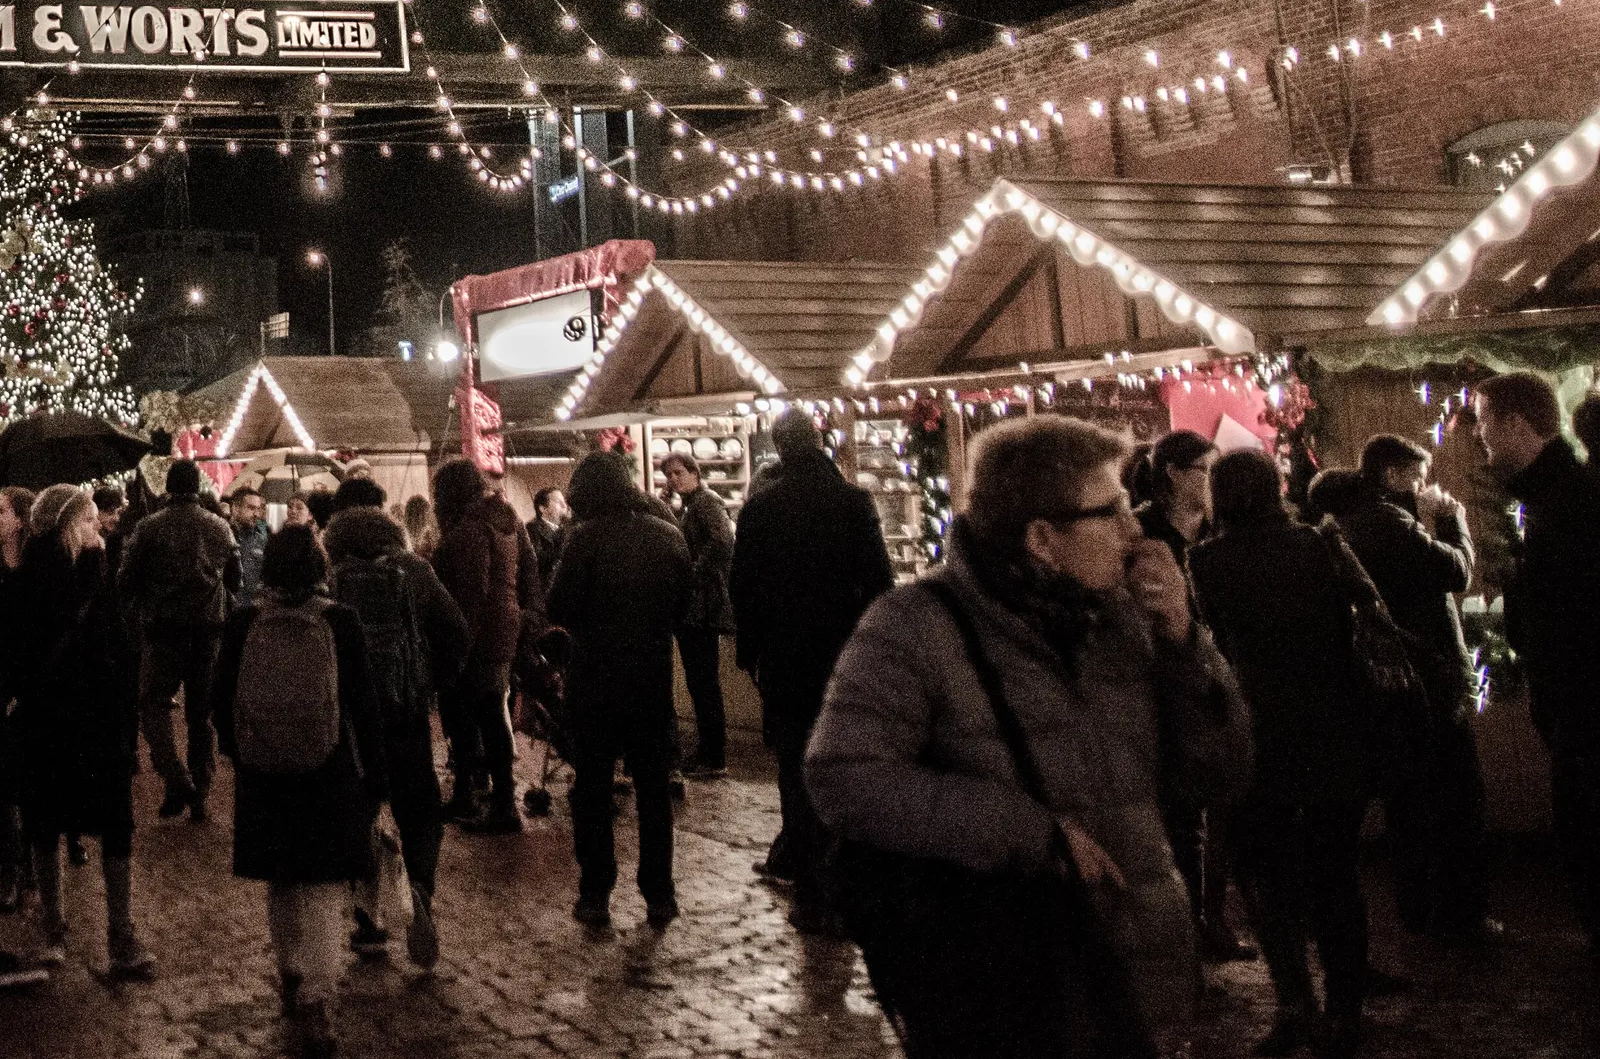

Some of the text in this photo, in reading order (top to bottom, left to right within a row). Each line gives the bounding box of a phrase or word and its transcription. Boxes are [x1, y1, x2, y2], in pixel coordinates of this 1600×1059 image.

[33, 3, 80, 53] &
[79, 5, 270, 56] WORTS
[277, 20, 377, 49] LIMITED
